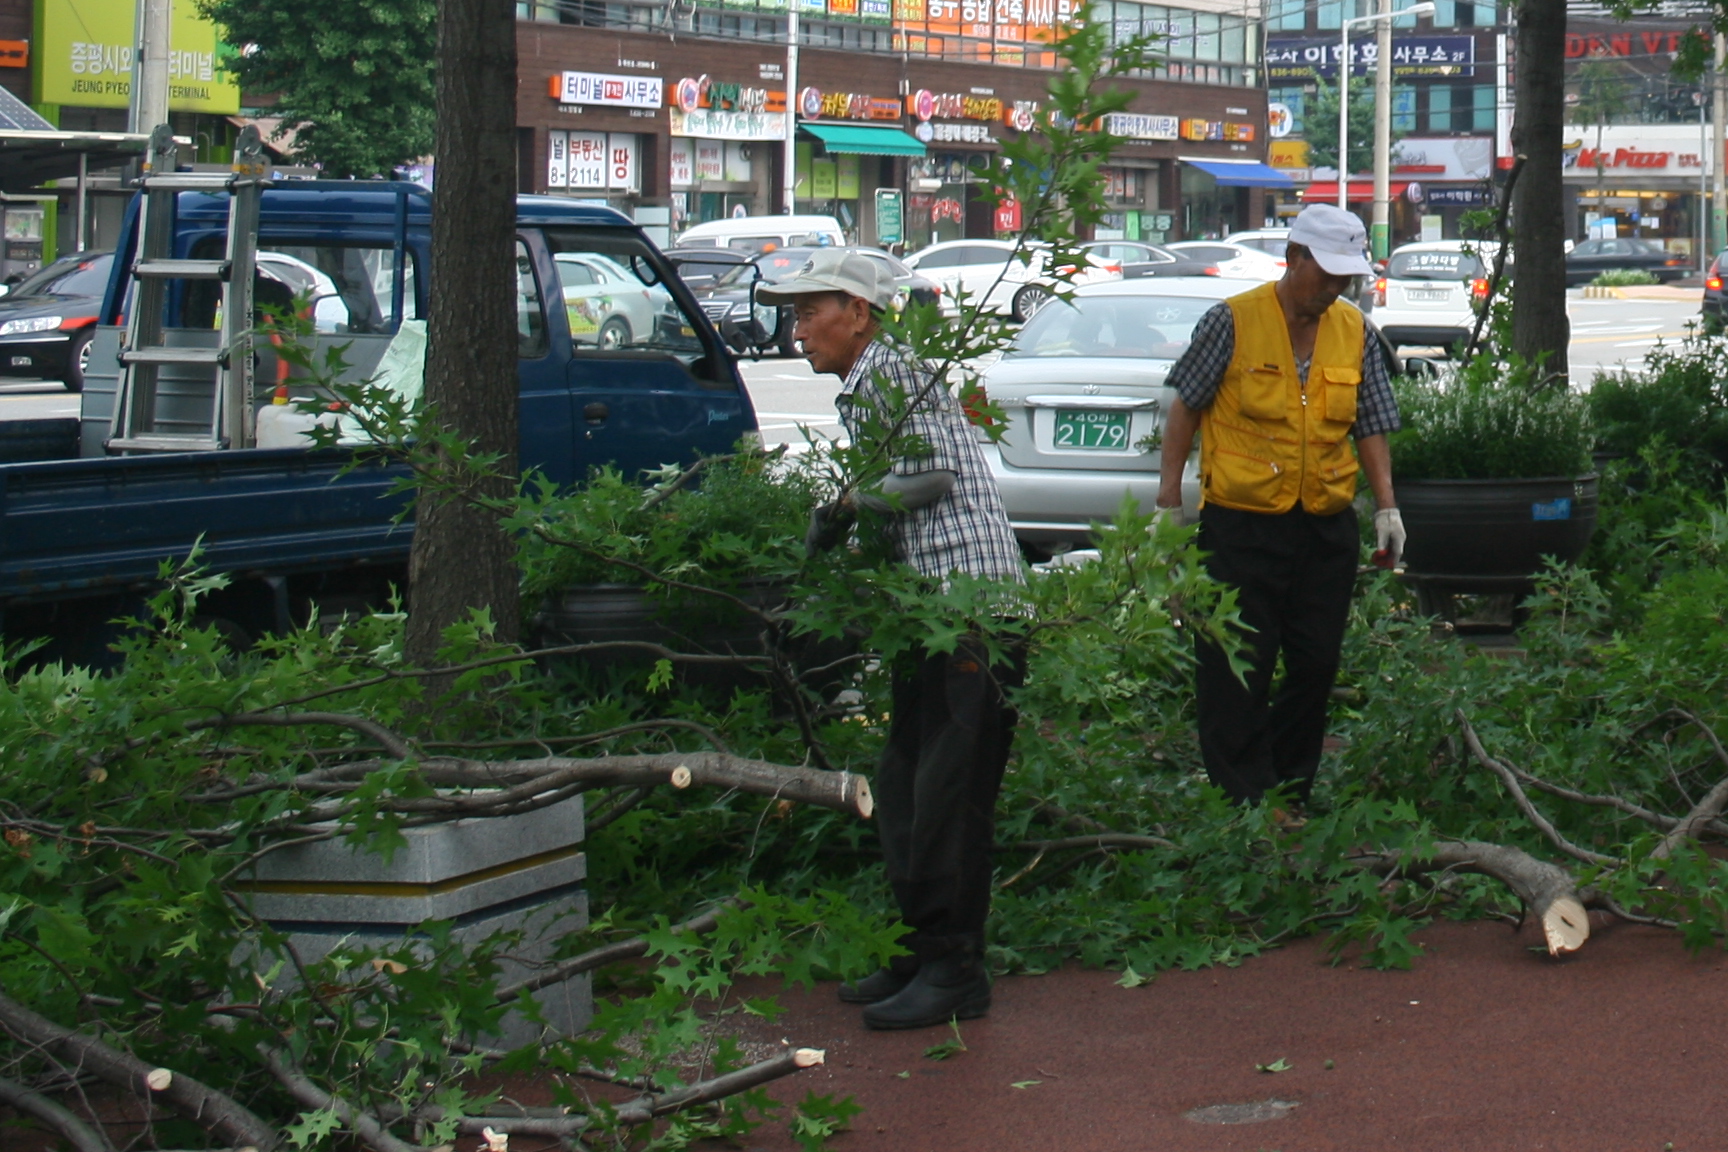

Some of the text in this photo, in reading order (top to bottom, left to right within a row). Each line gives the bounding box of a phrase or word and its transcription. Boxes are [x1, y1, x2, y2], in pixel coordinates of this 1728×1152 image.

[1394, 45, 1448, 64] 사무소
[1452, 51, 1465, 63] 2F
[72, 79, 103, 94] JEUNG
[106, 81, 131, 95] PYEO
[567, 76, 603, 100] 터미널
[625, 80, 659, 104] 사무소
[570, 139, 604, 161] 부동산
[613, 147, 630, 180] 땅
[1058, 423, 1124, 447] 2179
